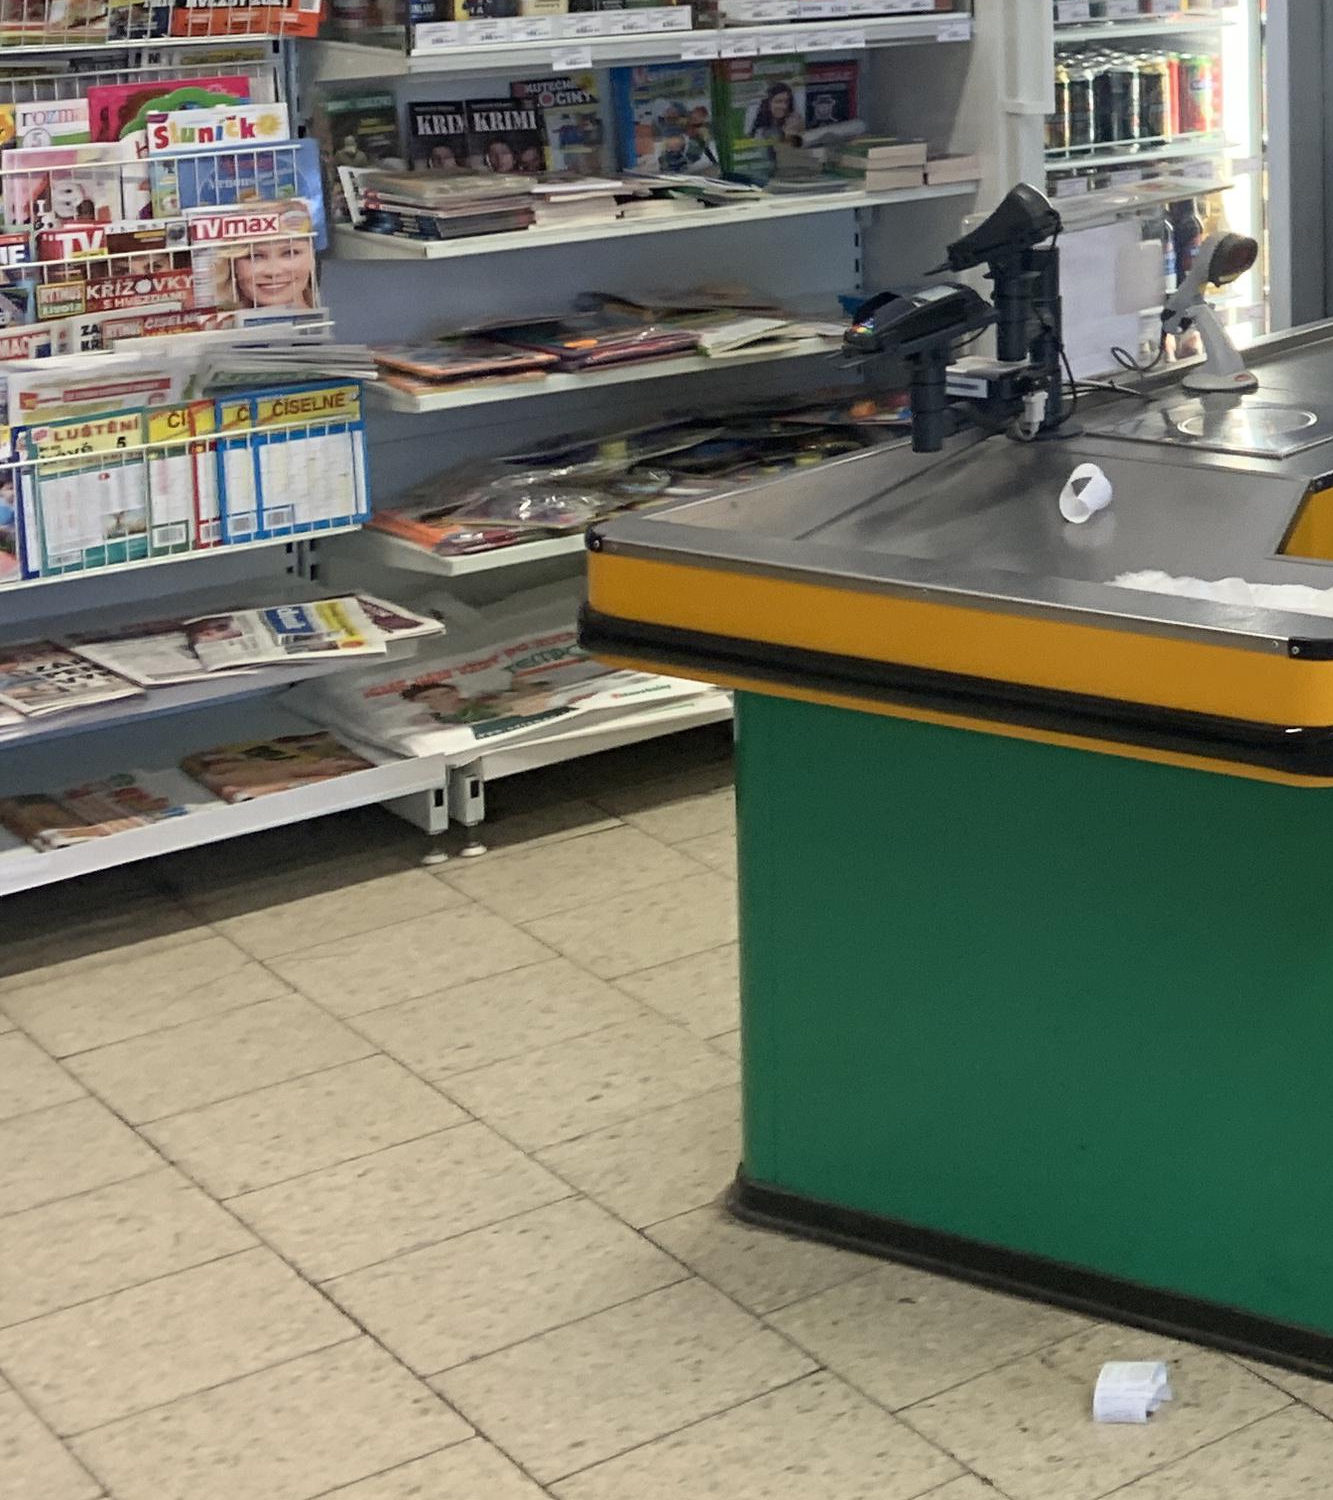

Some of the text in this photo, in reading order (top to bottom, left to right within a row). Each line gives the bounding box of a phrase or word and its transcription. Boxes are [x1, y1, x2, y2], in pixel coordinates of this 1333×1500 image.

[472, 109, 538, 133] KRIMI
[86, 273, 193, 301] KŘÍŽOVKY
[272, 391, 347, 417] ČÍSELNÉ
[53, 417, 140, 443] LUŠTĚNÍ
